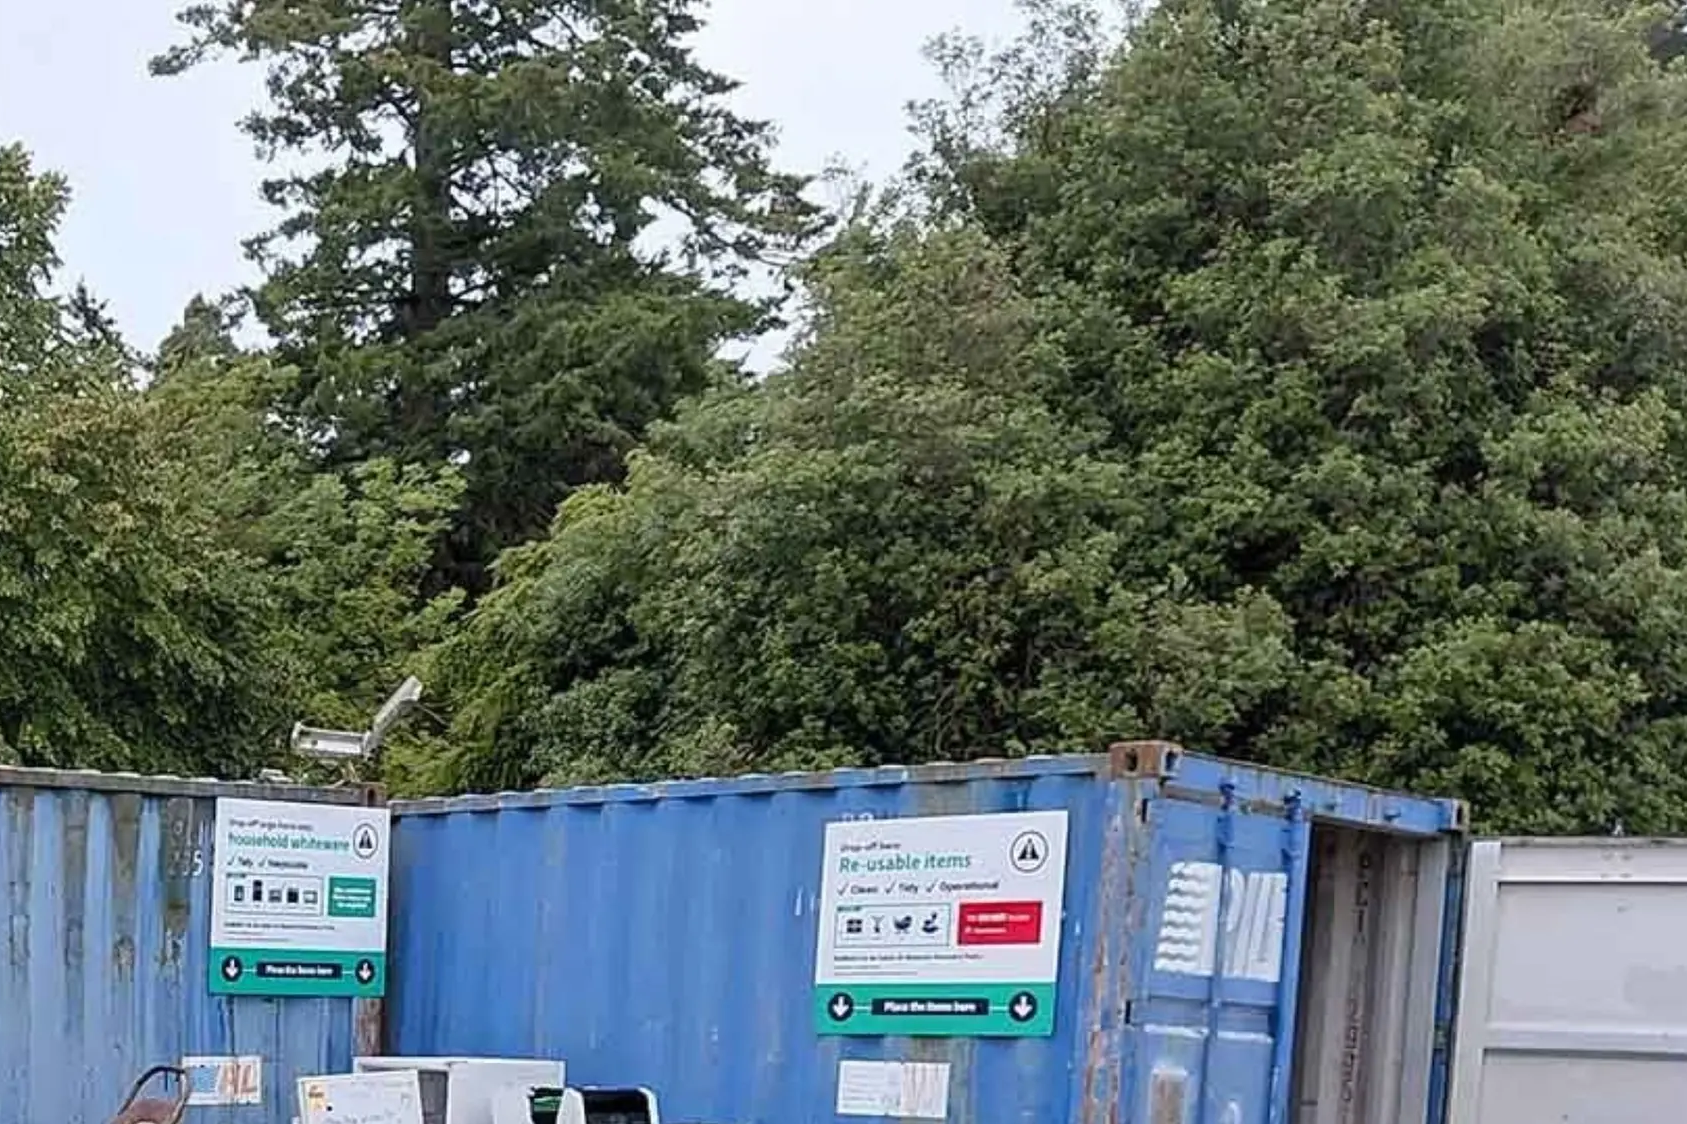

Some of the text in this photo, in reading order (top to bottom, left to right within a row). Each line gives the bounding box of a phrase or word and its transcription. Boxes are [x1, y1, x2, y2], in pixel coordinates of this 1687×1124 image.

[228, 831, 289, 850] household
[290, 835, 351, 851] whiteware
[838, 853, 973, 874] Re-usable items
[939, 880, 999, 894] Operational
[884, 1001, 907, 1013] Place
[910, 1001, 925, 1013] the
[954, 1001, 977, 1013] here
